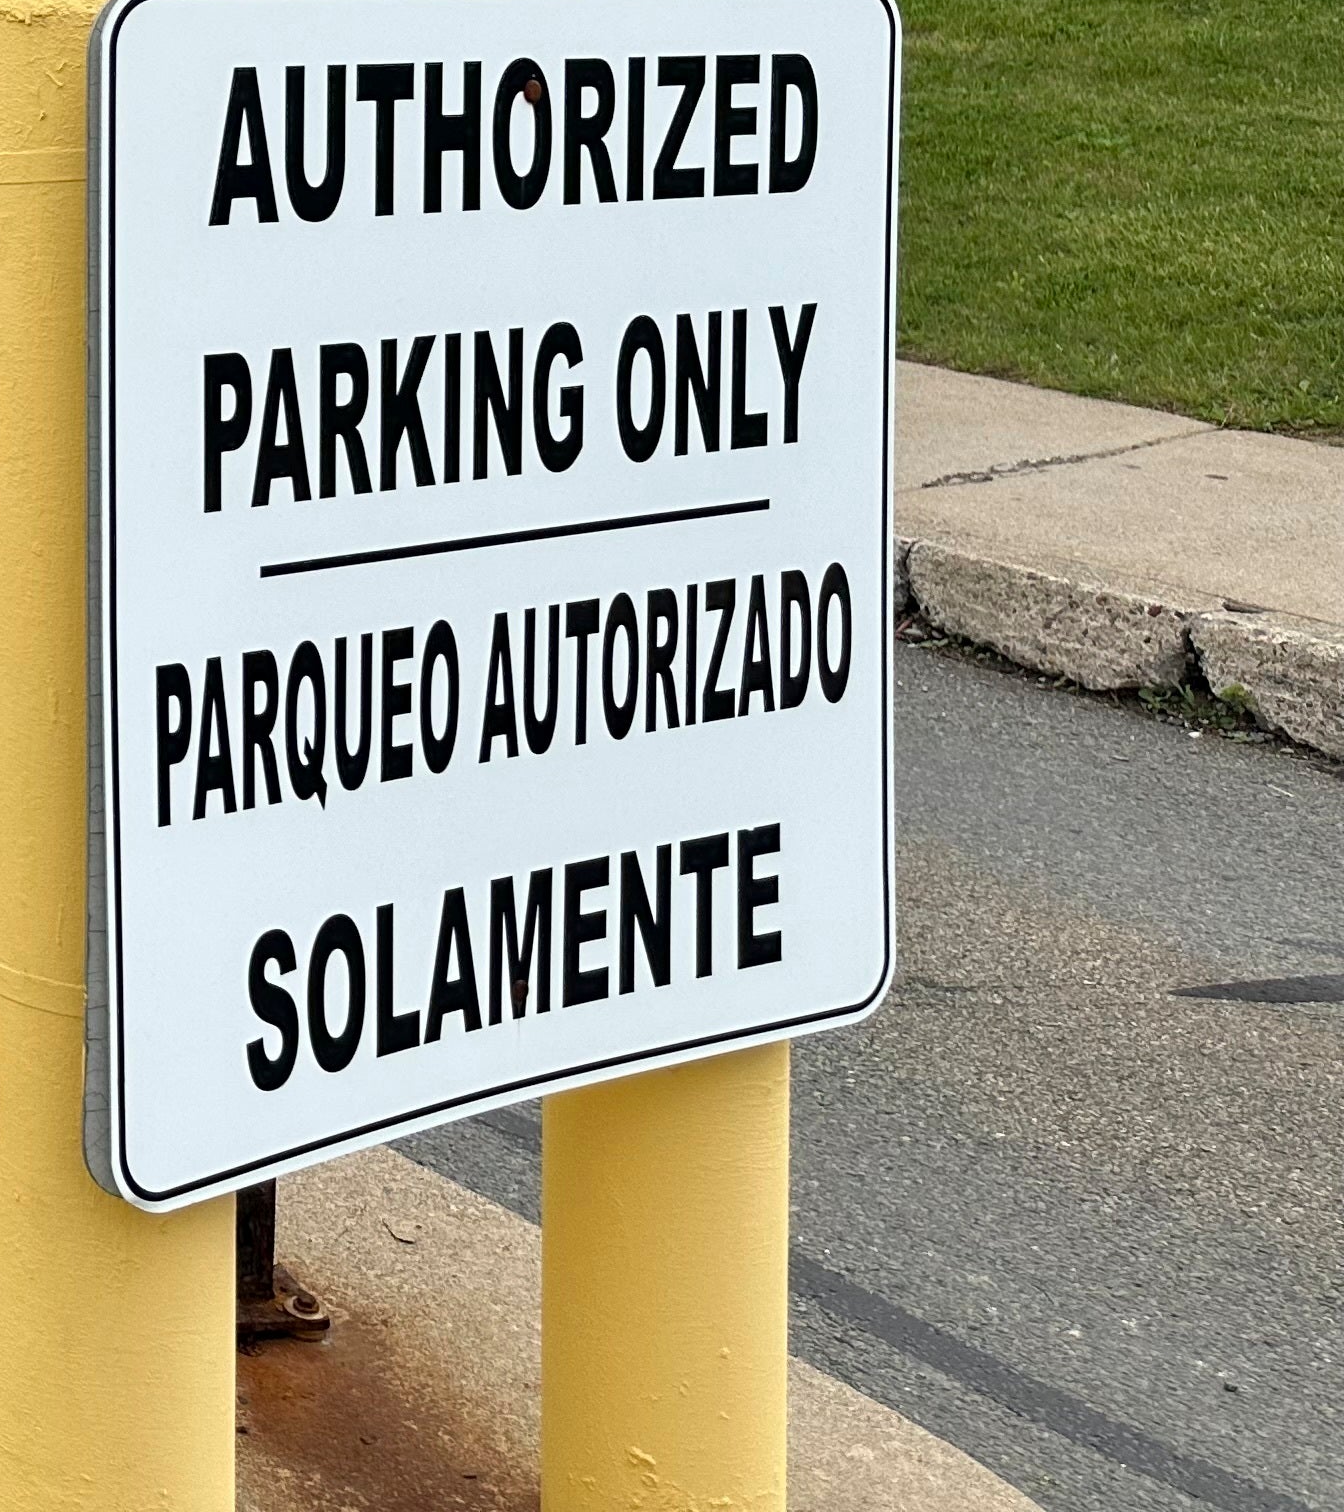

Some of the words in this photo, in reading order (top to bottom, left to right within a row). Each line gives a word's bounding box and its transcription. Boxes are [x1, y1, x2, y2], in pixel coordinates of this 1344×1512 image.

[208, 53, 819, 226] AUTHORIZED
[203, 321, 584, 513] PARKING
[617, 302, 818, 463] ONLY
[155, 619, 460, 828] PARQUEO
[478, 562, 853, 764] AUTORIZADO
[245, 823, 784, 1092] SOLAMENTE
